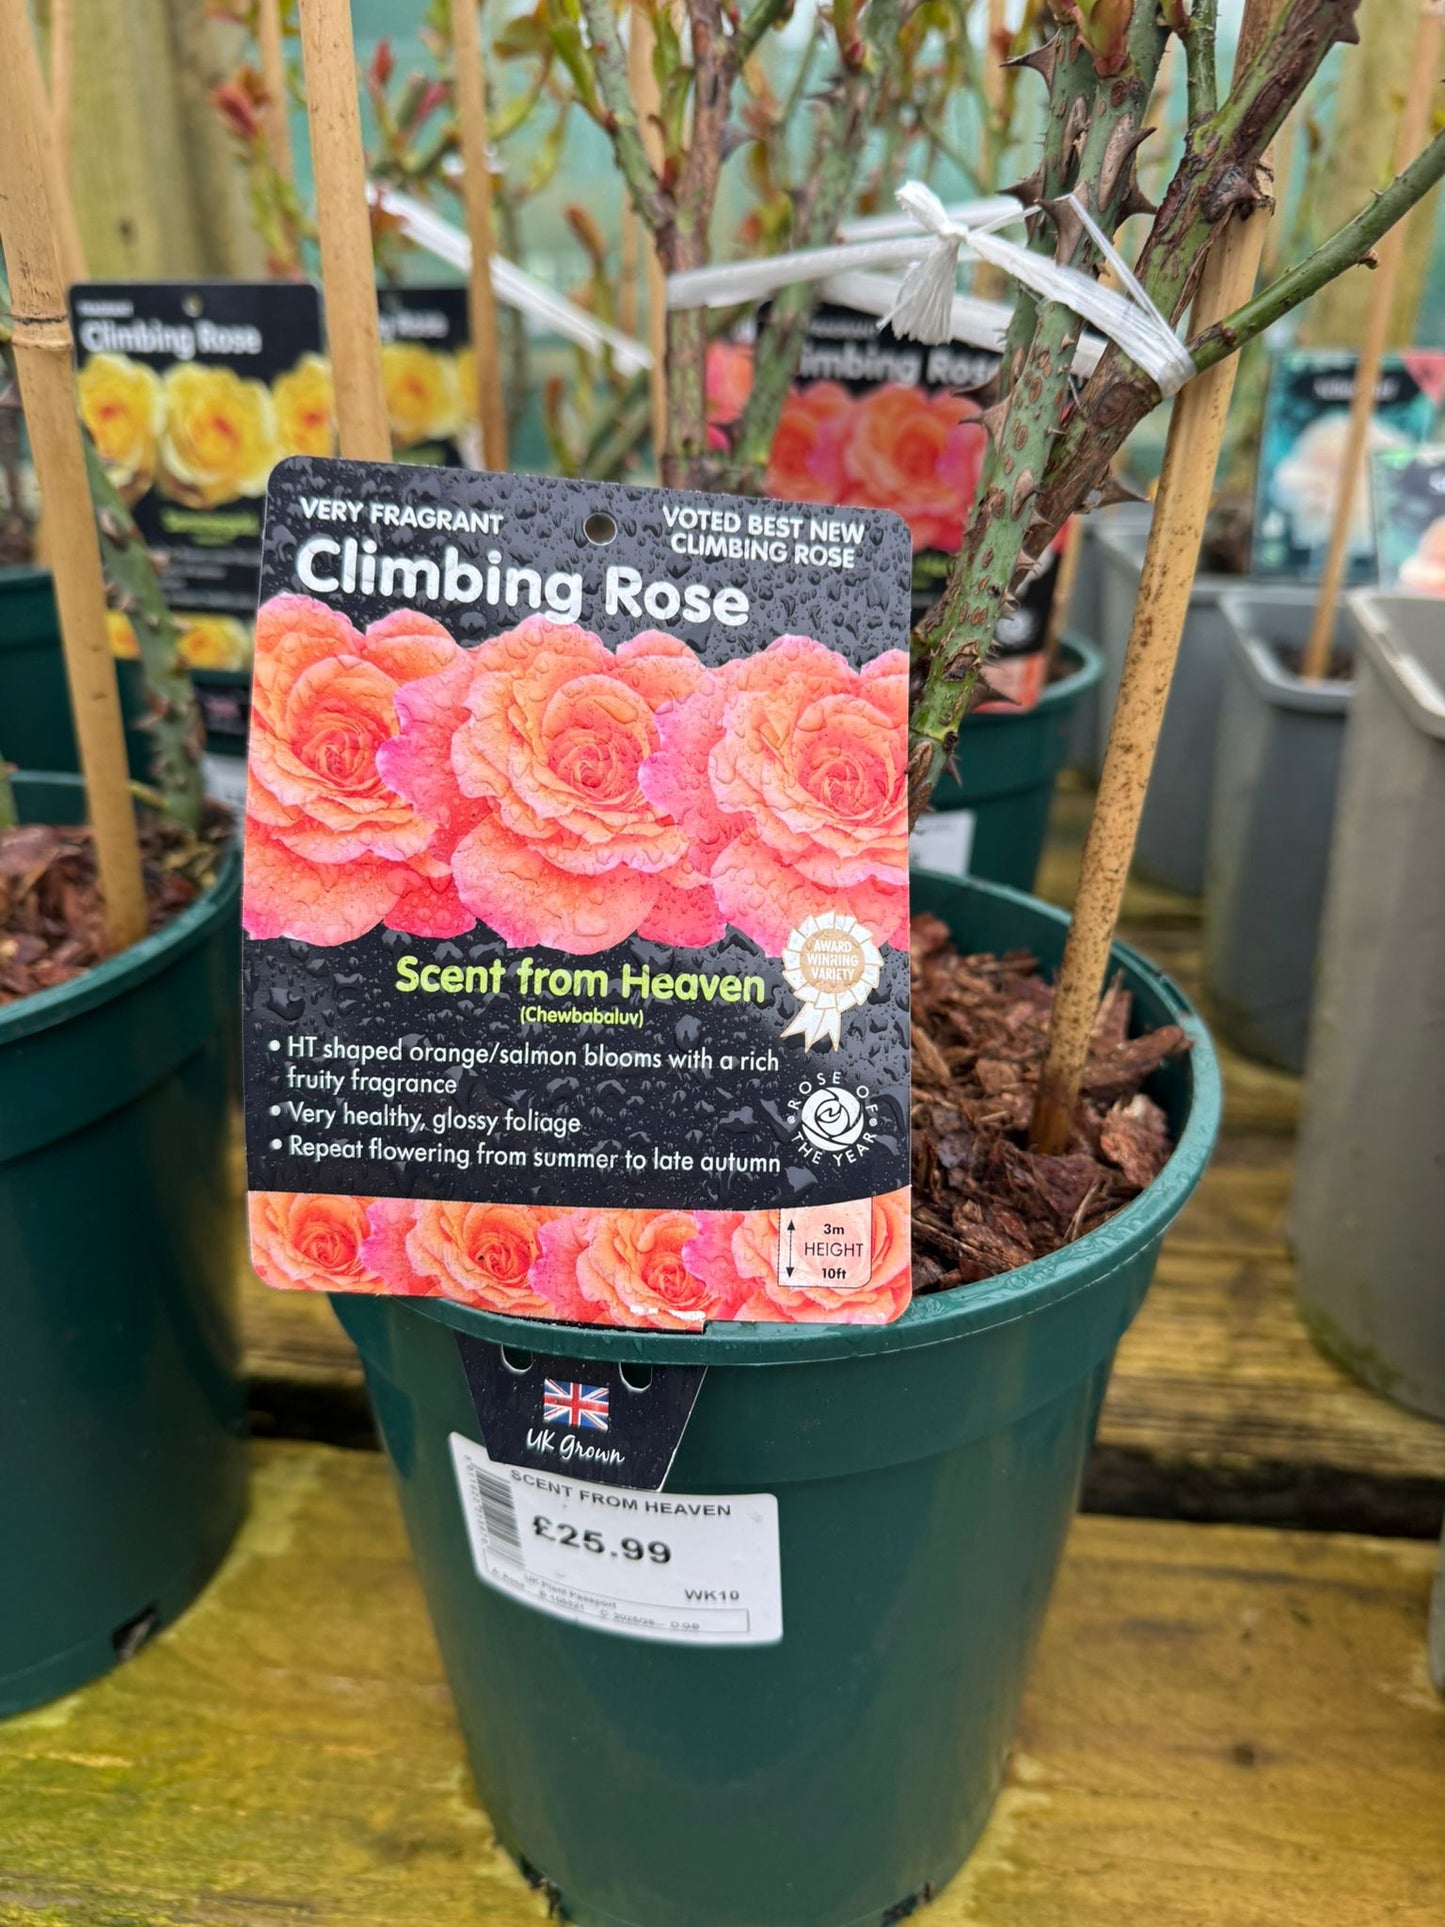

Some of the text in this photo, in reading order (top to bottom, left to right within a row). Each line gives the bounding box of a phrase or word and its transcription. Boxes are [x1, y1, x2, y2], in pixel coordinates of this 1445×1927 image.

[80, 318, 261, 360] Climbing Rose
[802, 338, 921, 386] imbing
[299, 498, 504, 535] VERY FRAGRANT
[662, 505, 865, 545] VOTED BEST NEW
[670, 533, 856, 569] CLIMBING ROSE
[295, 537, 750, 627] Climbing Rose
[806, 953, 858, 967] WINNING
[813, 939, 852, 953] AWARD
[395, 955, 765, 1003] Scent from Heaven
[811, 966, 856, 980] VARIETY
[520, 1005, 645, 1029] (Chewbabaluv)
[287, 1036, 779, 1071] HT shaped orange/salmon blooms with a rich
[287, 1066, 457, 1098] fruity fragrance
[290, 1101, 581, 1138] Very healthy, glossy foliage
[787, 1071, 879, 1167] ROSE OF THE YEAR
[289, 1134, 781, 1173] Repeat flowering from summer to late autumn
[823, 1223, 845, 1235] 3m
[804, 1242, 864, 1257] HEIGHT
[822, 1267, 847, 1280] 10ft
[526, 1427, 625, 1465] UK Grown
[510, 1469, 732, 1517] SCENT FROM HEAVEN
[532, 1514, 672, 1565] £25.99
[684, 1588, 740, 1602] WK10
